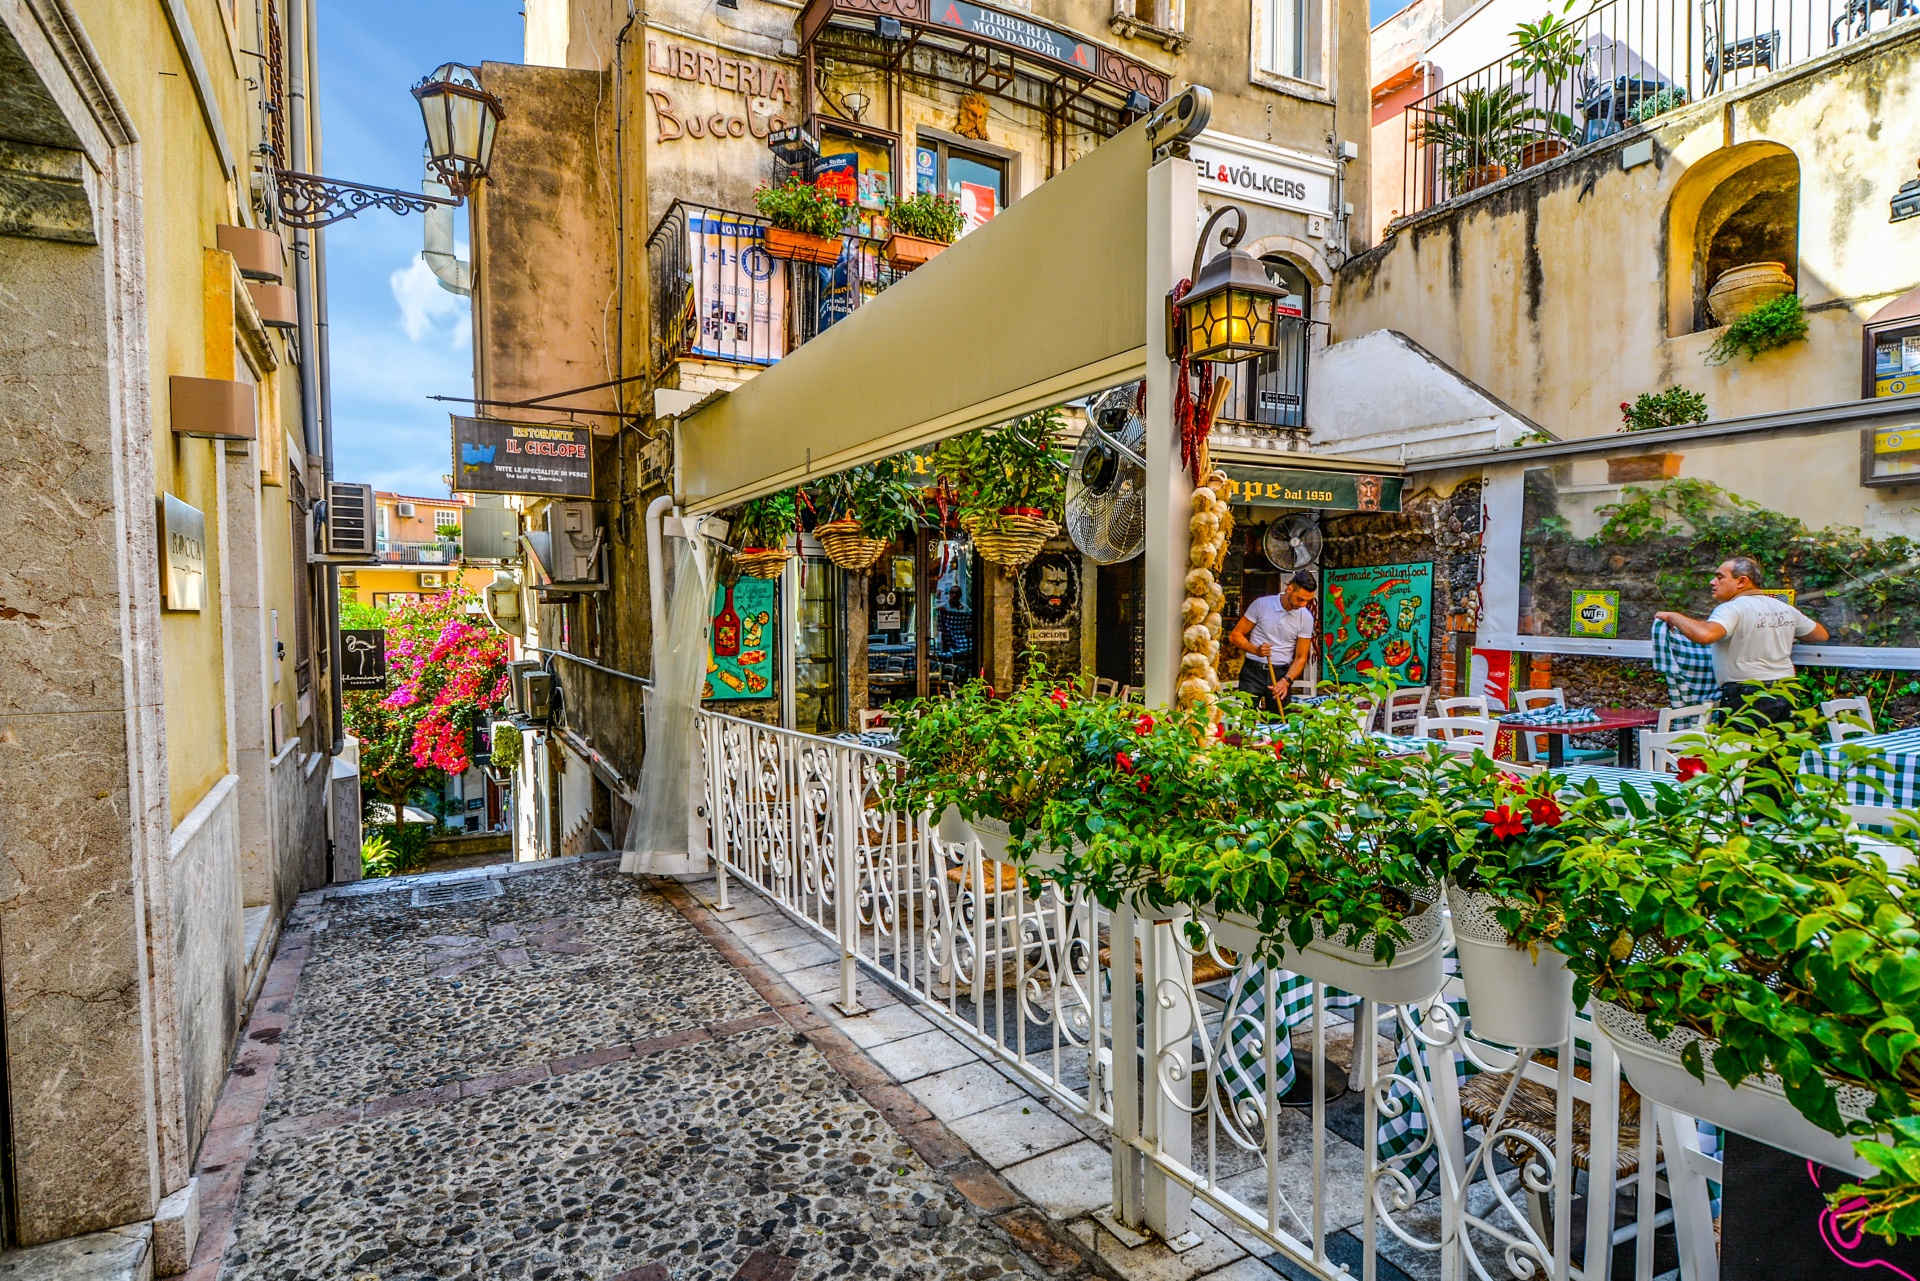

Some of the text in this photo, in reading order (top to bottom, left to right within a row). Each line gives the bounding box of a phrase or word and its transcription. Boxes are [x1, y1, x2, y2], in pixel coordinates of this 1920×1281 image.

[980, 9, 1053, 44] LIBRERIA
[971, 20, 1062, 59] MONDADORI
[648, 40, 792, 103] LIBRERIA
[1314, 221, 1320, 231] 2
[512, 426, 575, 442] RISTORANTE
[506, 439, 586, 458] IL CICLOPE
[495, 465, 513, 473] TUTTE
[1284, 489, 1303, 500] dal
[1306, 490, 1333, 502] 1950
[171, 531, 202, 561] ROCCA
[1327, 568, 1371, 583] Homemade
